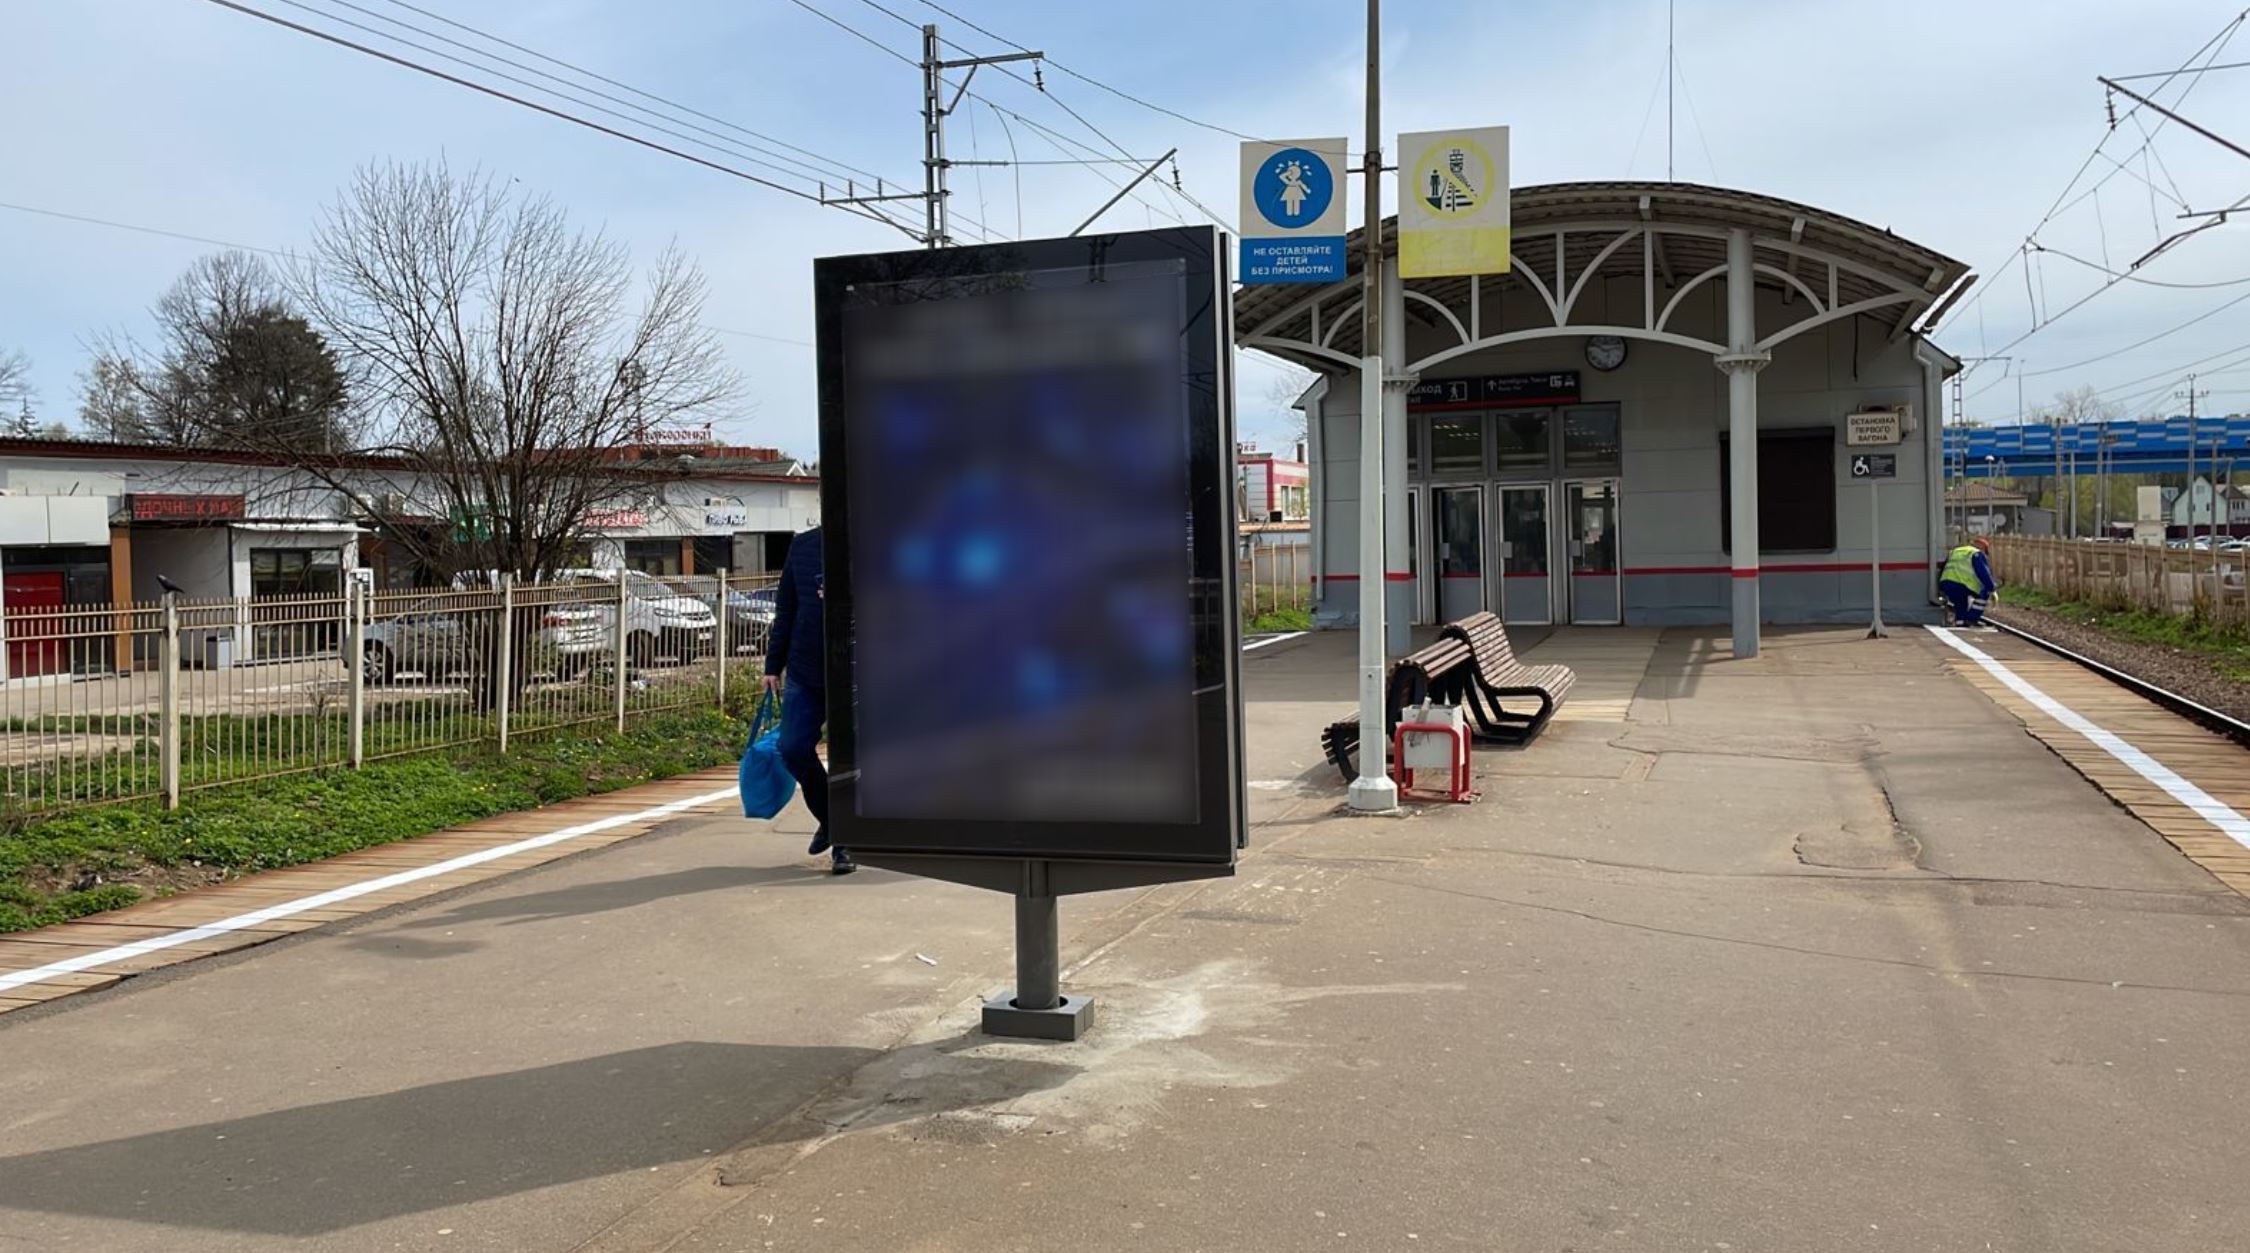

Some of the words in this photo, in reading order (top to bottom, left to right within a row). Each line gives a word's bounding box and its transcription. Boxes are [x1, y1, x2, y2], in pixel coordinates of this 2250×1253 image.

[1254, 247, 1267, 256] НЕ
[1268, 245, 1332, 256] ОСТАВЛЯЙТЕ
[1276, 255, 1308, 266] ДЕТЕЙ
[1251, 266, 1270, 275] БЕЗ
[1272, 264, 1333, 275] ПРИСМОТРА!
[1850, 417, 1896, 426] ОСТАНОВКА
[1855, 425, 1891, 434] ПЕРВОГО
